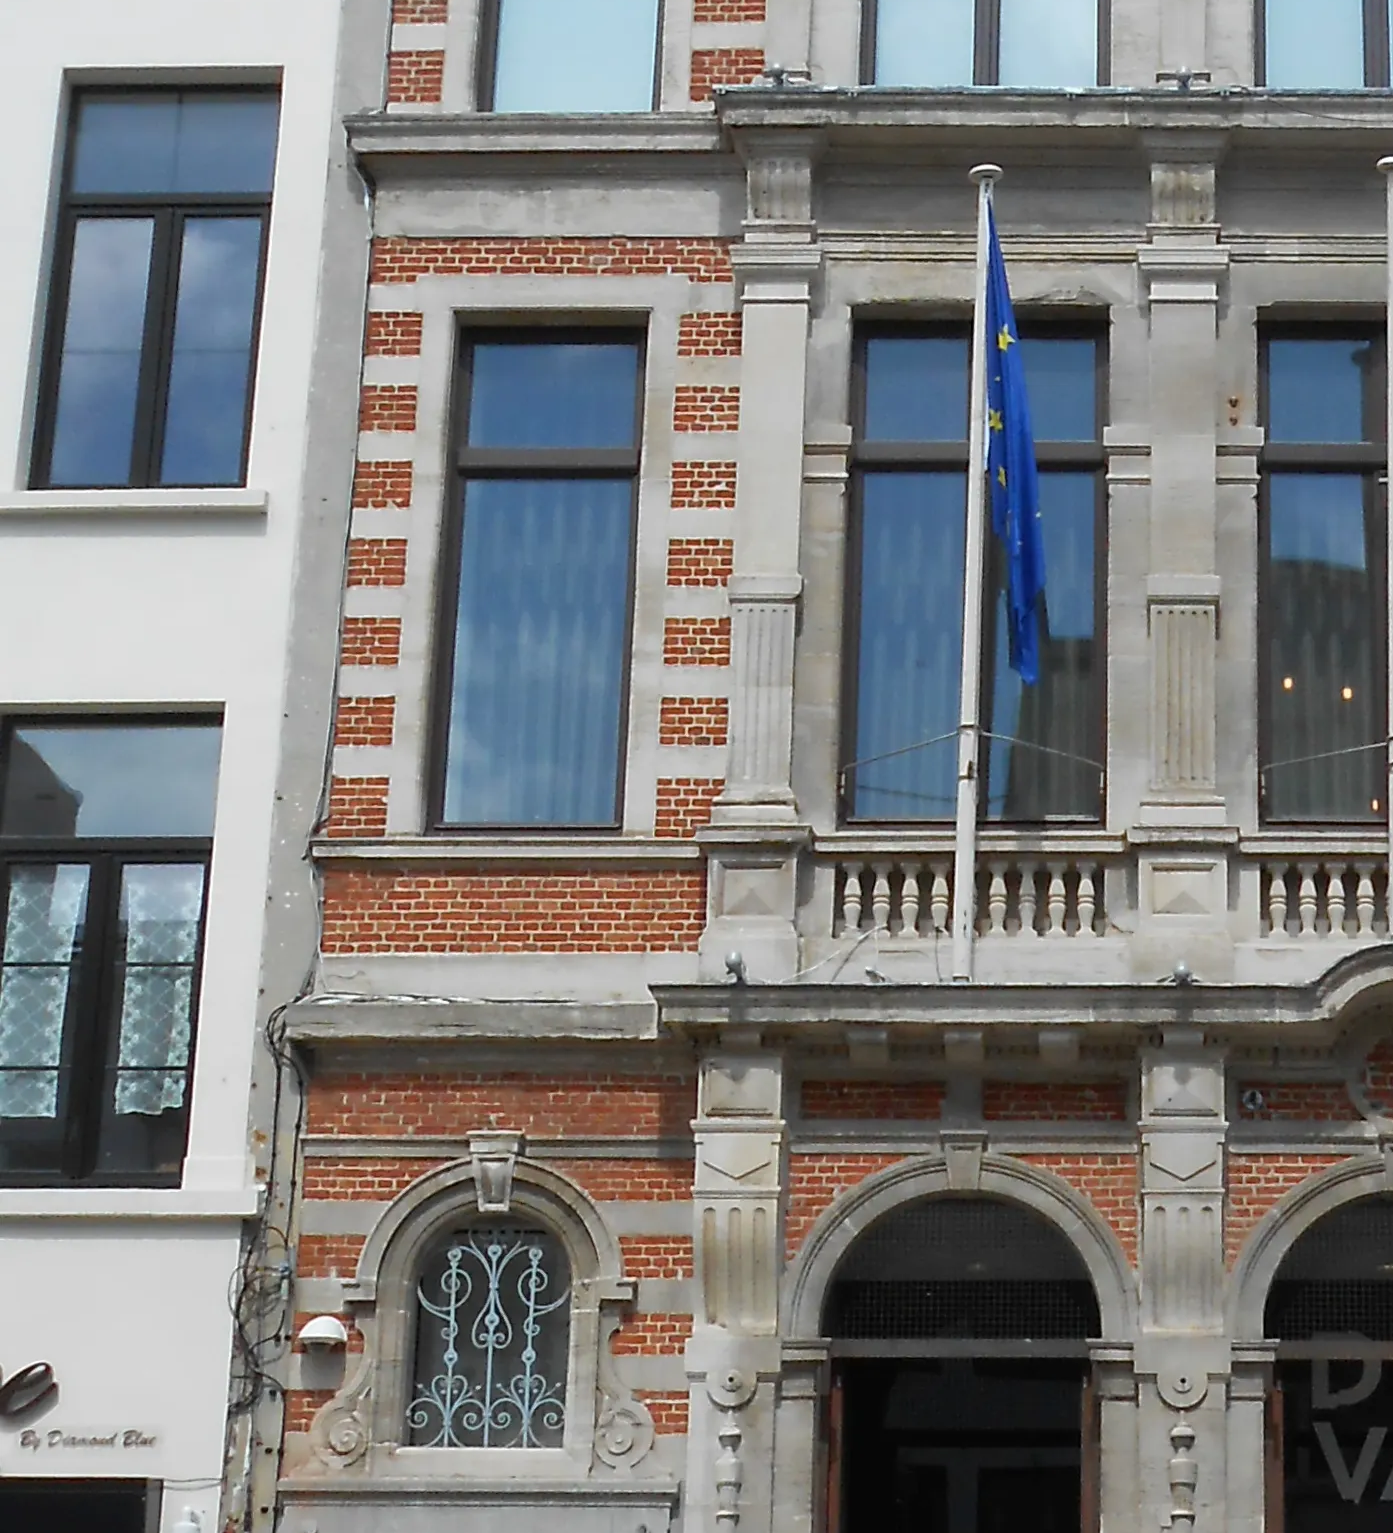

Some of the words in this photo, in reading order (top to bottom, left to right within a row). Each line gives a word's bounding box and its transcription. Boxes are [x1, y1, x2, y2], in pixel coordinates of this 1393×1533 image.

[20, 1429, 41, 1453] By
[47, 1429, 118, 1449] Diamond
[123, 1429, 157, 1449] Blue
